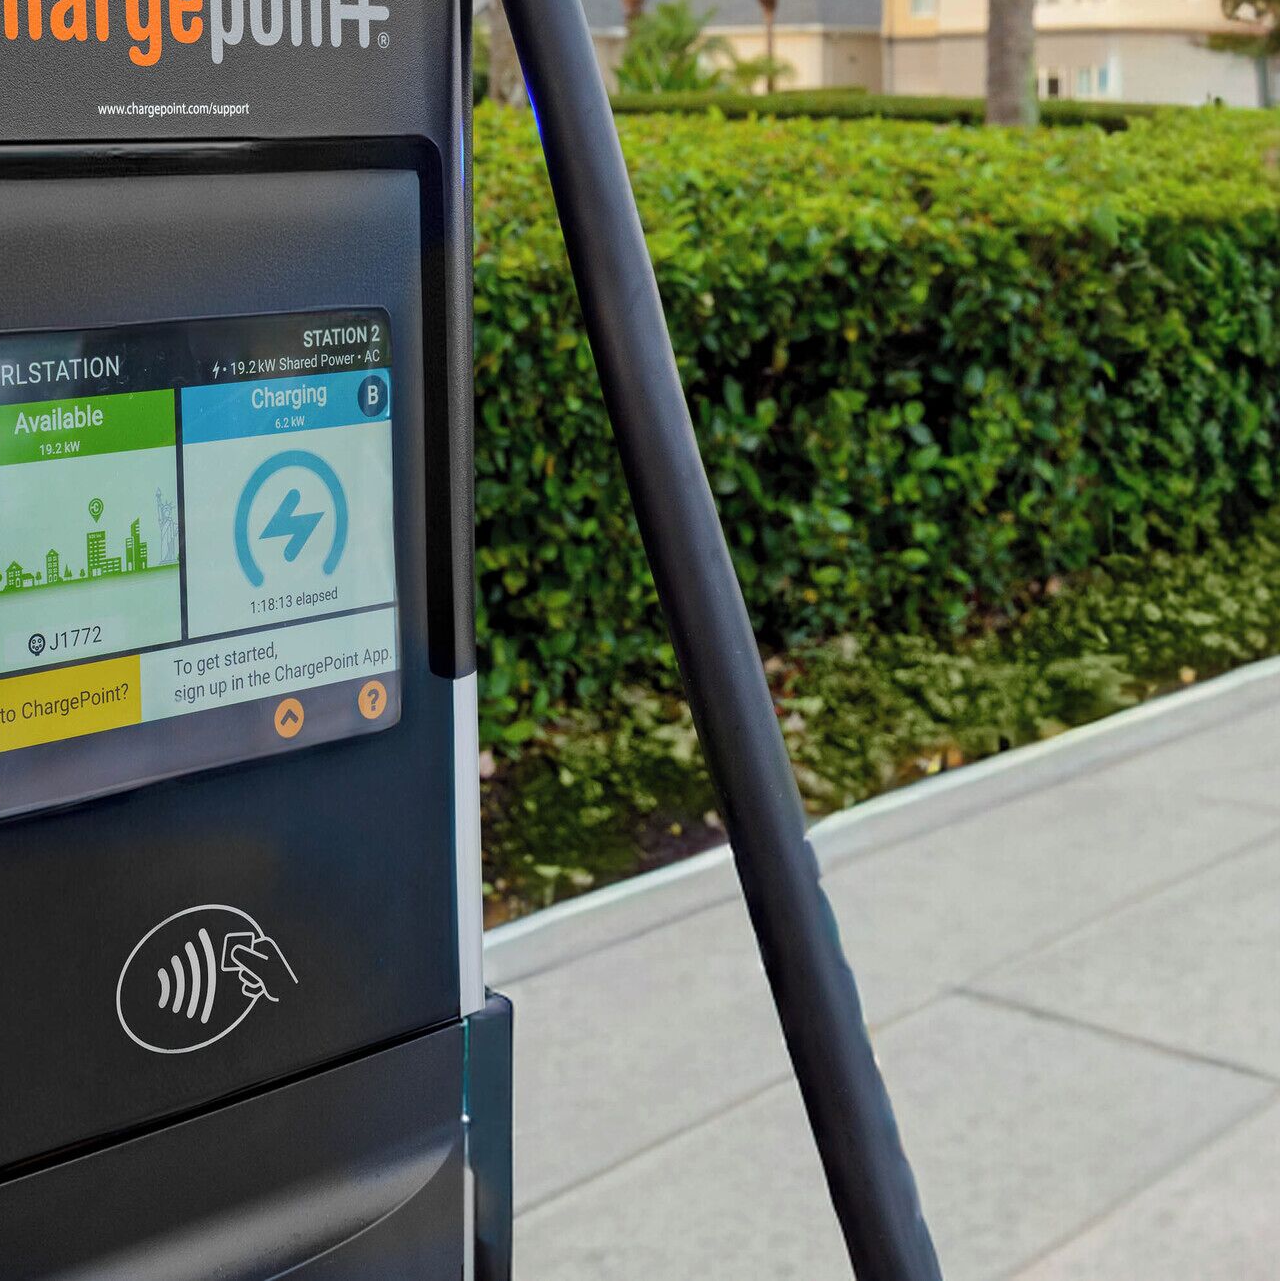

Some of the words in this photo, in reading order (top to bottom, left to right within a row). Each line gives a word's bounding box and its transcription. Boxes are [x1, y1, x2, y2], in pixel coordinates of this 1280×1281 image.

[97, 101, 250, 118] www.chargepoint.com/support
[303, 325, 368, 348] STATION
[371, 324, 381, 343] 2
[279, 355, 318, 371] Shared
[321, 353, 355, 368] Power
[364, 349, 381, 363] AC
[251, 384, 328, 410] Charging
[367, 385, 379, 405] B
[14, 404, 104, 435] Available
[275, 417, 290, 429] 6.2
[291, 416, 305, 428] kW
[39, 442, 62, 456] 19.2
[64, 440, 81, 454] kW
[250, 594, 293, 614] 1:18:13
[296, 586, 338, 607] elapsed
[49, 625, 102, 651] J1772
[174, 659, 192, 676] To
[196, 654, 220, 676] get
[224, 641, 278, 668] started,
[174, 682, 205, 704] sign
[209, 679, 227, 698] up
[231, 674, 244, 691] in
[248, 670, 271, 687] the
[275, 652, 359, 681] ChargePoint
[363, 647, 392, 667] App.
[0, 707, 16, 724] to
[21, 682, 129, 720] ChargePoint?
